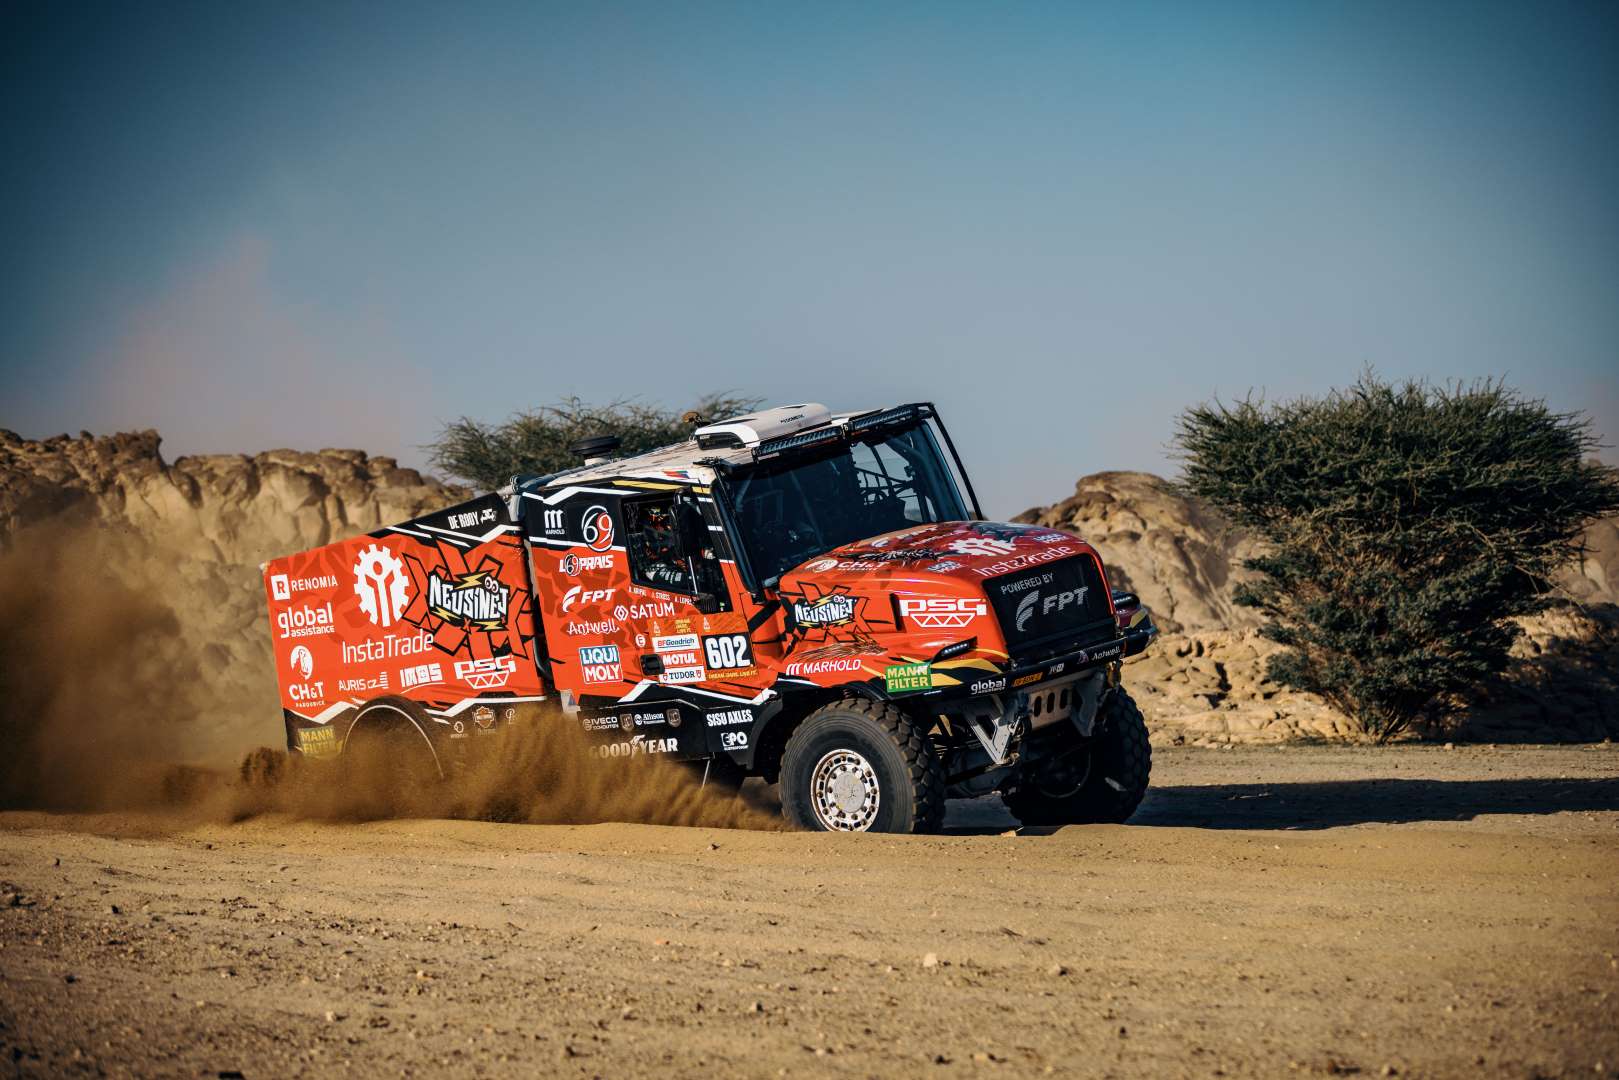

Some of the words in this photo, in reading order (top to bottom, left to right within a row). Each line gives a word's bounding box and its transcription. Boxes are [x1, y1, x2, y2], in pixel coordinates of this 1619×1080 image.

[447, 514, 460, 530] DE
[459, 511, 480, 527] ROOY
[291, 575, 338, 592] RENOMIA
[1001, 576, 1043, 595] POWERED
[1043, 573, 1055, 584] BY
[581, 588, 616, 604] FPT
[1042, 585, 1089, 616] FPT
[630, 602, 675, 619] SATUM
[277, 602, 334, 639] global
[290, 624, 335, 638] assistance
[342, 628, 434, 664] InstaTrade
[657, 637, 695, 647] BFGoodrich
[580, 648, 618, 665] LIQUI
[662, 653, 697, 665] MOTUL
[584, 665, 620, 682] MOLY
[669, 670, 695, 680] TUDOR
[803, 659, 862, 675] MARHOLD
[887, 665, 929, 679] MANN
[288, 681, 324, 701] CH&T
[888, 676, 930, 690] FILTER
[970, 678, 1007, 695] global
[591, 716, 618, 725] IVECO
[706, 710, 728, 728] SISU
[727, 708, 754, 725] AXLES
